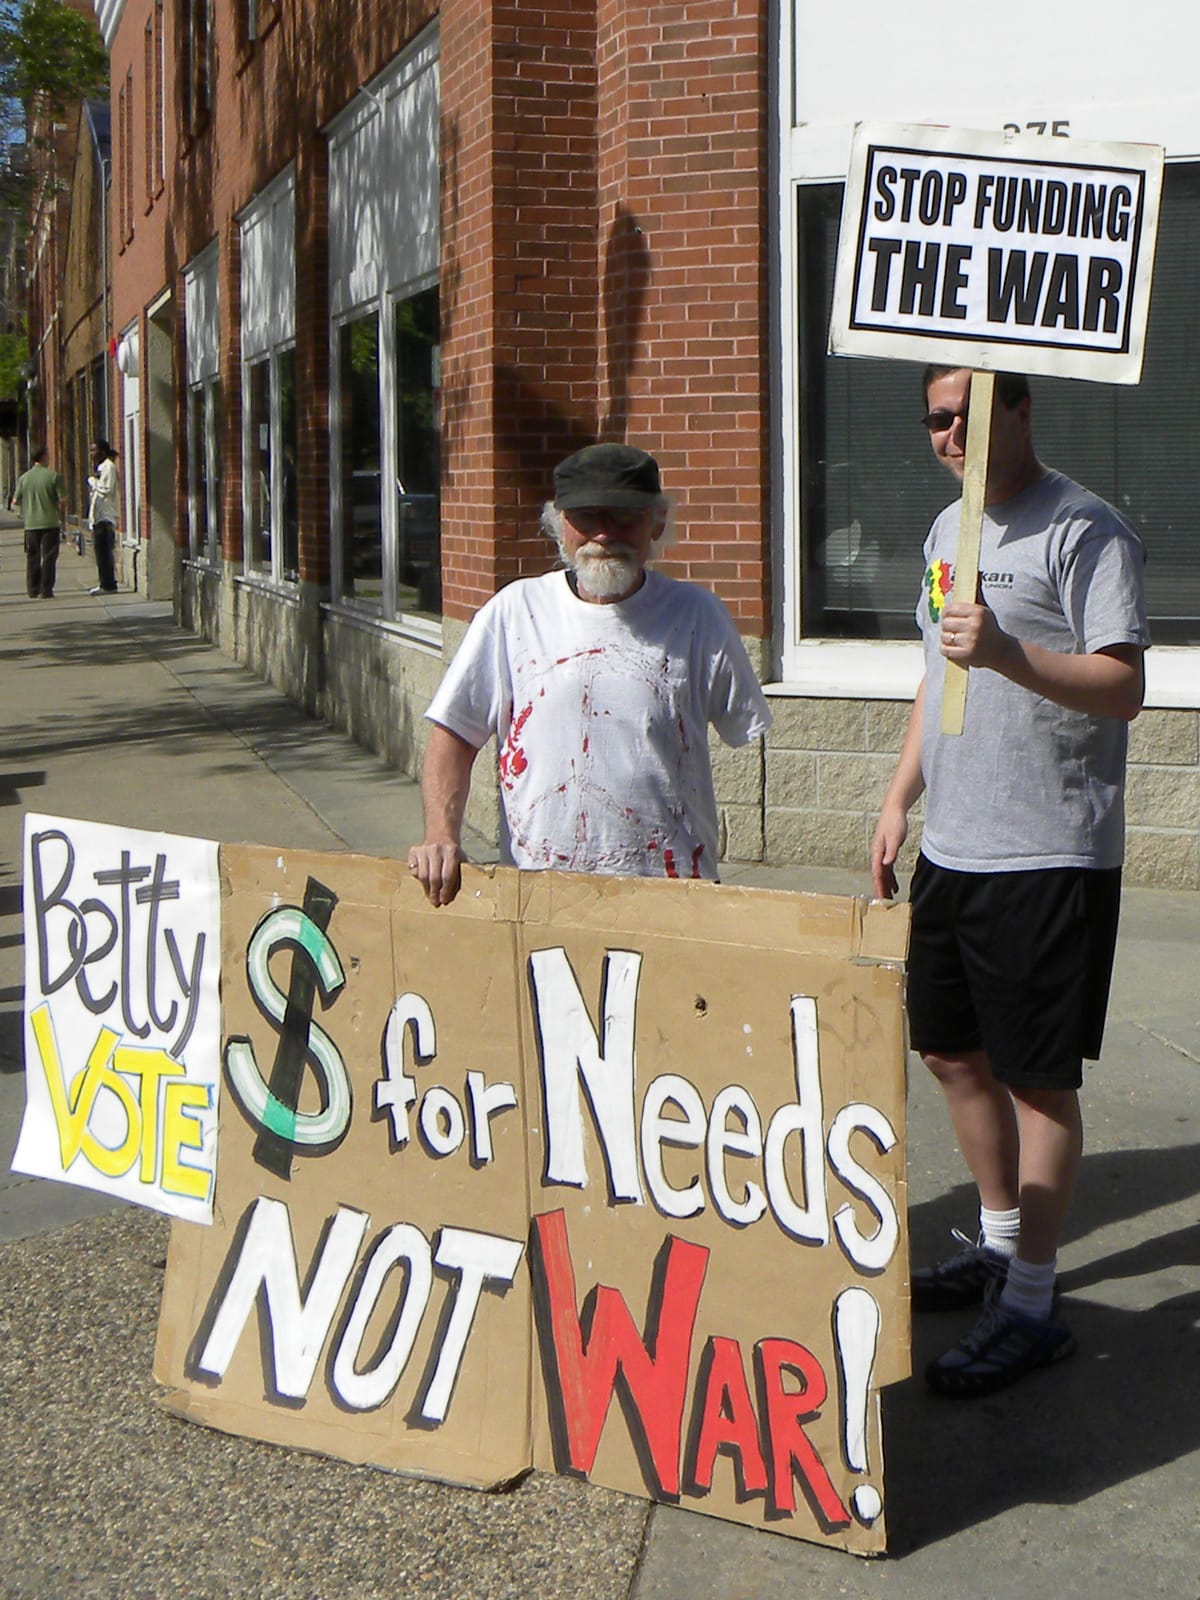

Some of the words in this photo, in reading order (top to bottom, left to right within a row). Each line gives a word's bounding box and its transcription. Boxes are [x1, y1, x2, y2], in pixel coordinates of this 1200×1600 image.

[868, 237, 973, 320] THE
[987, 247, 1123, 334] WAR
[874, 166, 967, 227] STOP
[973, 174, 1132, 242] FUNDING
[31, 829, 206, 1059] Betty
[30, 1001, 215, 1202] VOTE
[371, 992, 518, 1166] for
[529, 946, 900, 1276] Needs
[184, 1195, 525, 1430] NOT
[527, 1207, 884, 1532] WAR!
